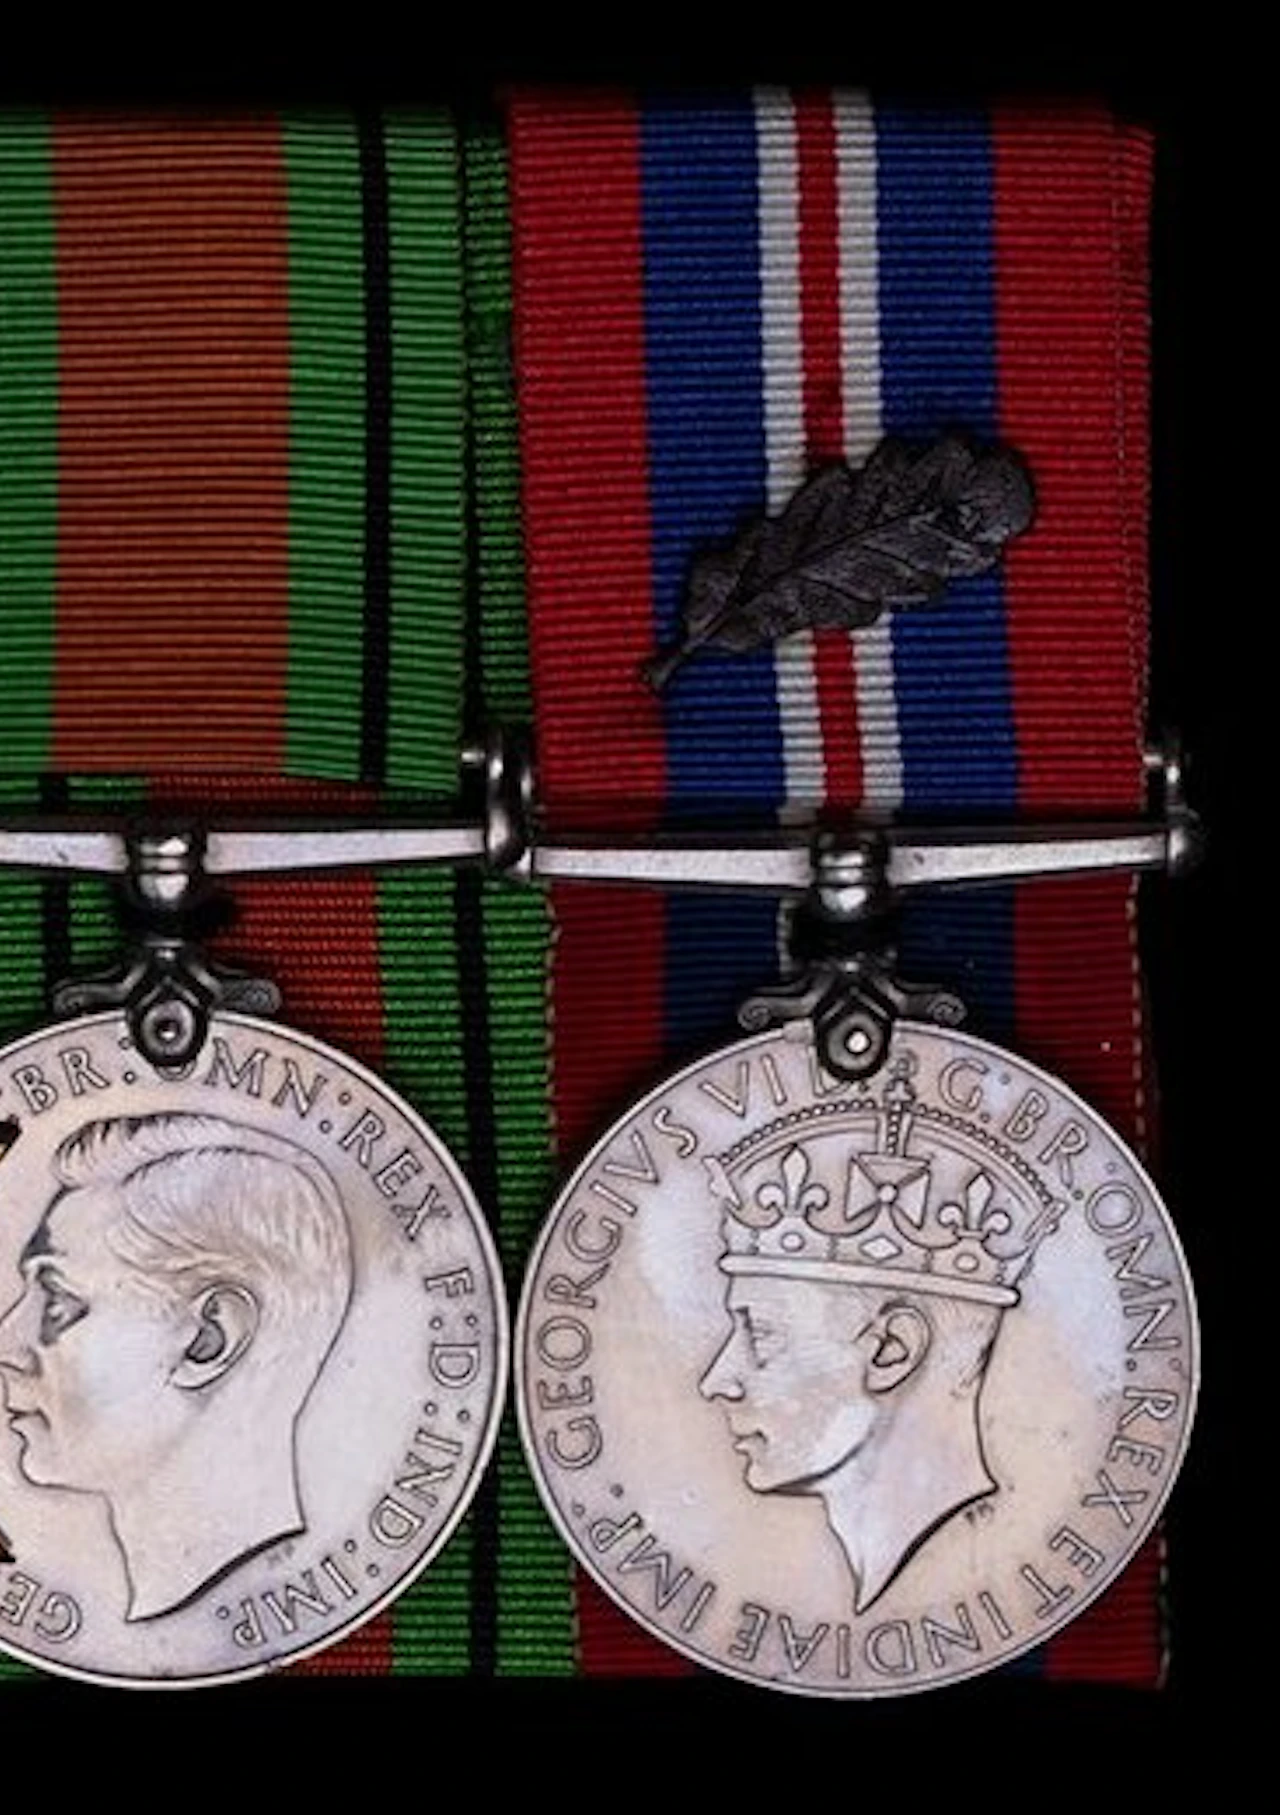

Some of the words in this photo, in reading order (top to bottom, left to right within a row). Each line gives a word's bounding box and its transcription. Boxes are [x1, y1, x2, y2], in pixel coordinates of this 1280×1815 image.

[698, 1053, 789, 1119] VI
[339, 1109, 451, 1242] REX
[538, 1106, 700, 1472] GEORGIVS
[1083, 1386, 1180, 1529] REX
[1020, 1528, 1106, 1618] ET
[729, 1589, 1013, 1679] INDIAE
